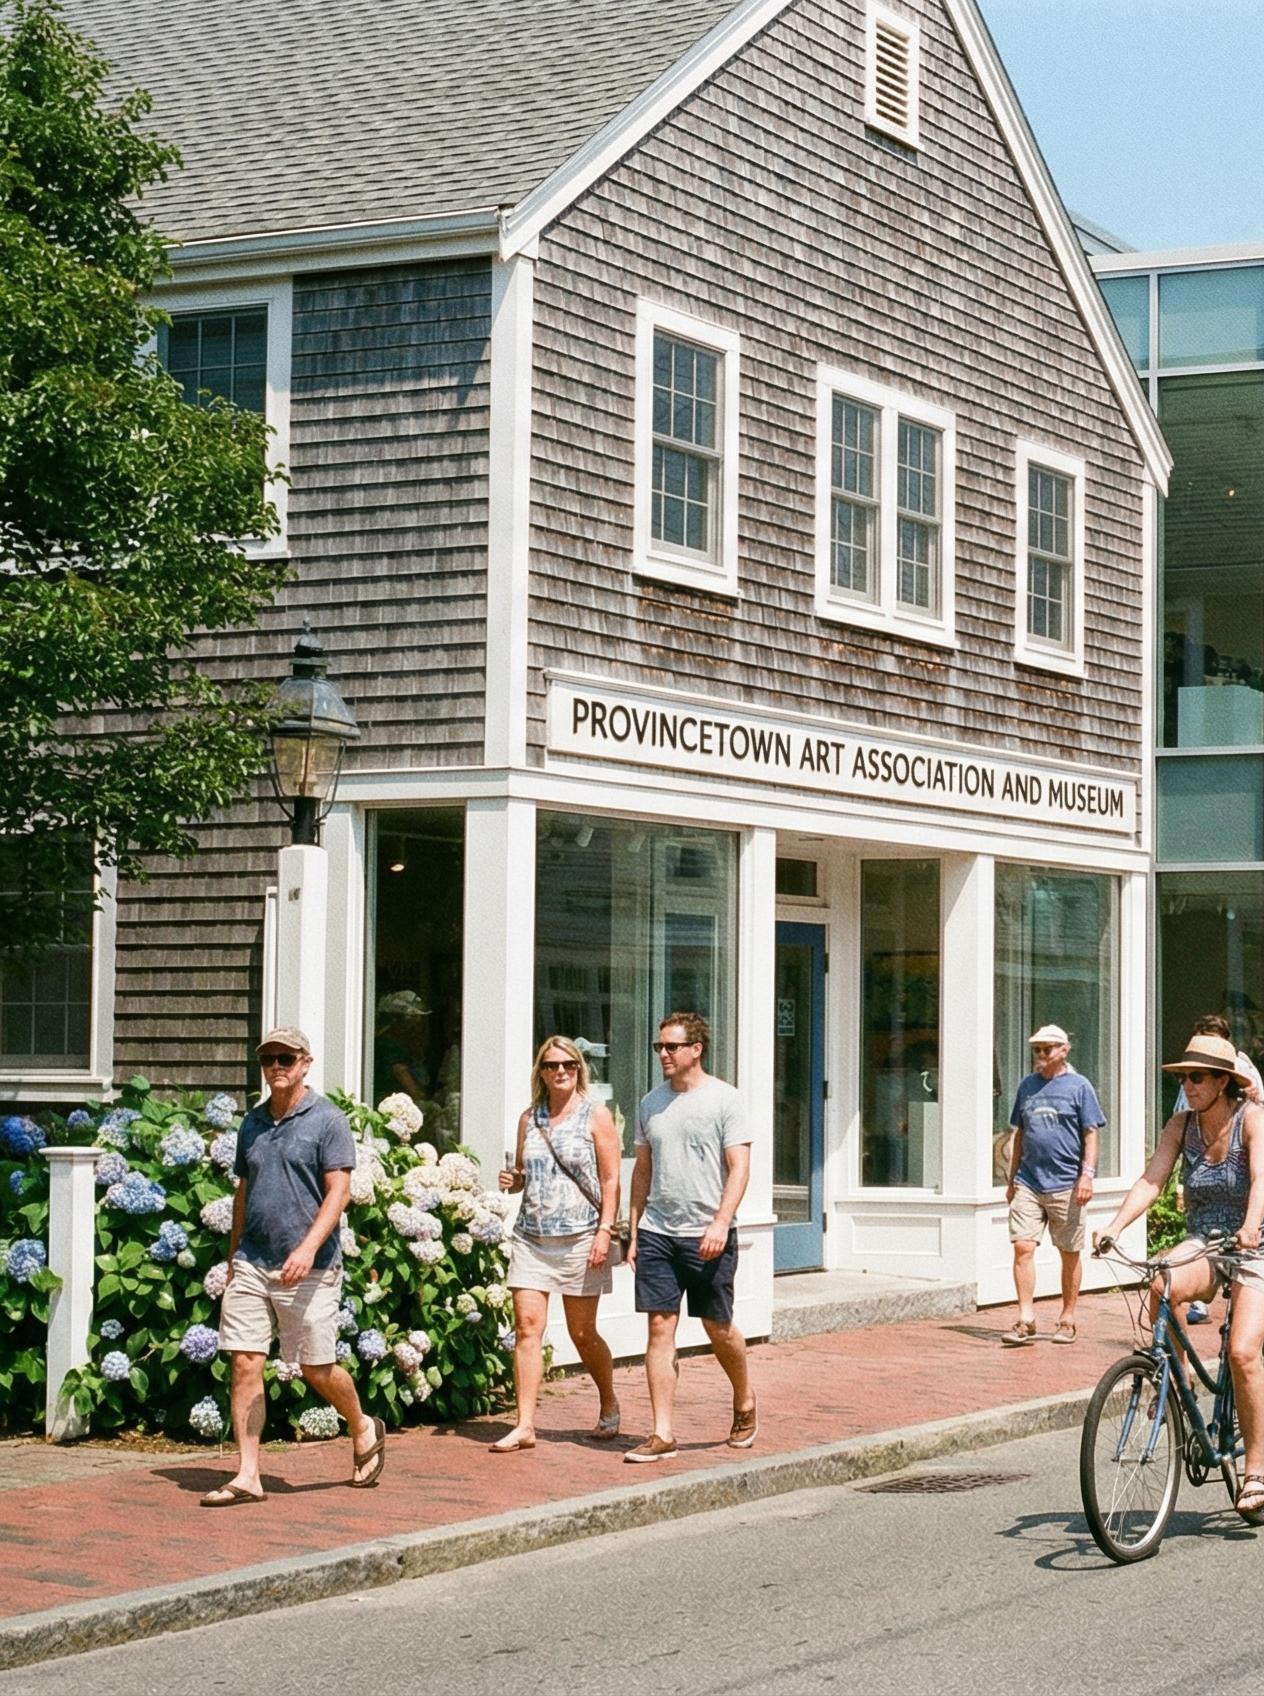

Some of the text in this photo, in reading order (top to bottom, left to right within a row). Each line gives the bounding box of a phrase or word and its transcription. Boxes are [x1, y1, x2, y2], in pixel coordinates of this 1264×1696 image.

[573, 697, 1123, 818] PROVINCETOWN ART ASSOCIATION AND MUSEUM
